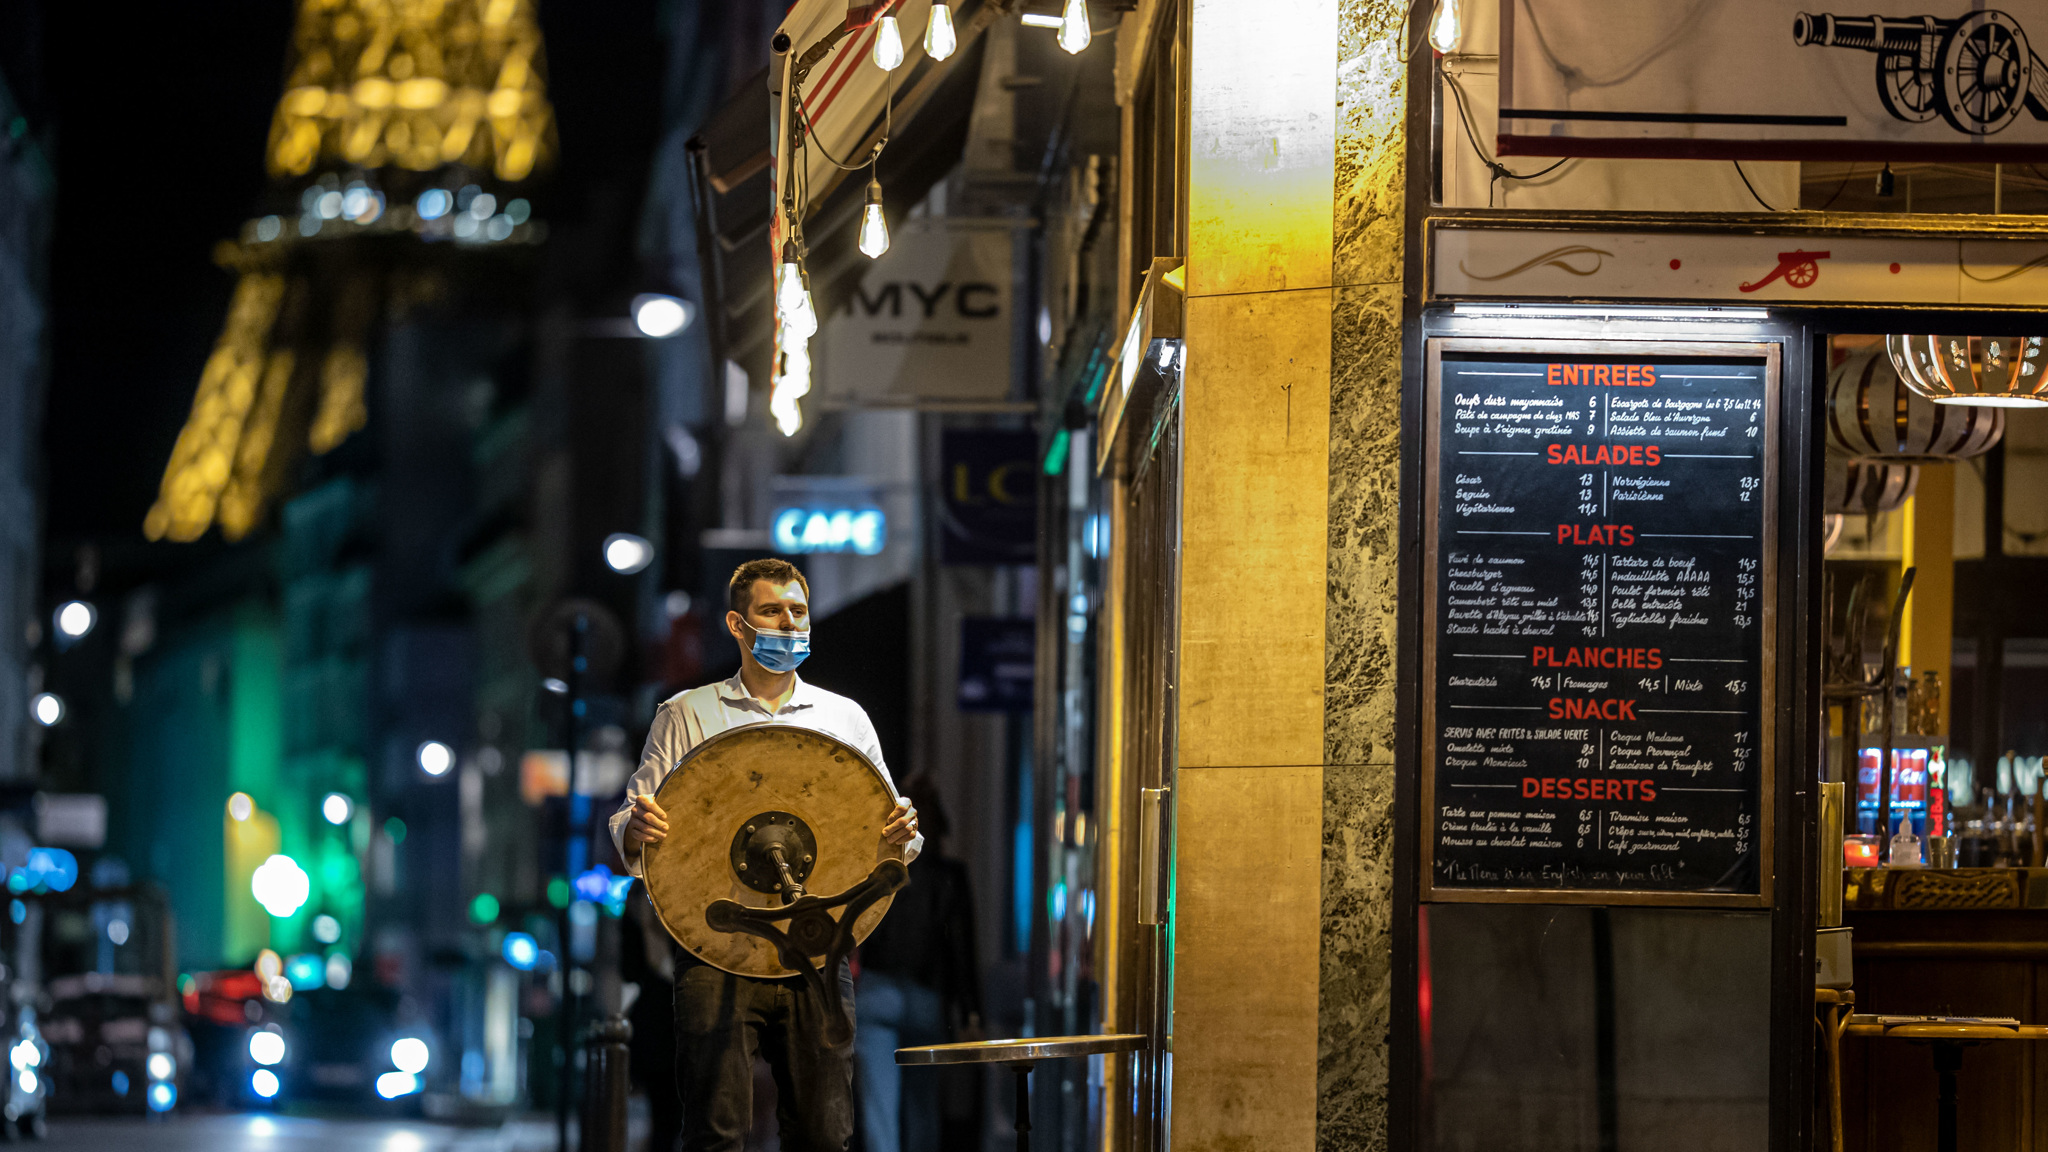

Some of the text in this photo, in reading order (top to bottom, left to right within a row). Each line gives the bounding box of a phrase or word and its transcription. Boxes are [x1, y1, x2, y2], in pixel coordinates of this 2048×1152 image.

[848, 282, 998, 318] MYC
[1547, 364, 1656, 387] ENTREES
[1455, 393, 1596, 411] Oeufs durs mayonnaise 6
[1611, 397, 1649, 411] Escargots
[1652, 399, 1662, 408] de
[1665, 399, 1702, 411] Bourgogne
[1715, 399, 1720, 408] 6
[1724, 399, 1734, 411] 7,5
[1752, 399, 1761, 409] 14
[1455, 409, 1596, 423] Pâté de campagne de chez MAS 7
[1610, 412, 1757, 425] Salade Bleu d'Auvergne 6
[1455, 423, 1595, 438] Soupe à l'oignon gratinée 9
[1610, 425, 1758, 440] Assiette de saumon fumé 10
[1547, 444, 1661, 466] SALADES
[1455, 474, 1593, 486] César 13
[1613, 476, 1760, 490] Norvégienne 13,5
[1455, 489, 1592, 501] Seguin 13
[1740, 492, 1750, 501] 12
[1456, 503, 1598, 516] Végétarienne 11,5
[1557, 524, 1635, 546] PLATS
[1448, 554, 1469, 564] Pavé
[1473, 554, 1484, 565] de
[1582, 555, 1599, 568] 14,5
[1611, 555, 1648, 567] Tartare
[1653, 557, 1664, 567] de
[1738, 558, 1757, 572] 14,5
[1581, 569, 1598, 582] 14,5
[1611, 571, 1754, 585] Andouillette AAAAA 15,5
[1449, 581, 1598, 596] Rouelle d'agneau 14,9
[1611, 585, 1643, 595] Poulet
[1644, 587, 1686, 600] fermier
[1737, 588, 1754, 599] 14,5
[1448, 596, 1497, 606] Camembert
[1537, 598, 1558, 606] miel
[1580, 598, 1598, 609] 13,5
[1611, 599, 1747, 611] Belle entrecôte 21
[1448, 609, 1483, 619] Bavette
[1587, 610, 1599, 623] 14,5
[1611, 612, 1666, 628] Tagliatelles
[1733, 615, 1752, 629] 13,5
[1446, 624, 1597, 637] Steack haché à cheval 14,5
[1532, 646, 1663, 669] PLANCHES
[1449, 676, 1551, 689] Charcuterie 14,5
[1563, 677, 1660, 693] Fromages 14,5
[1675, 680, 1747, 695] Mixte 15,5
[1549, 697, 1636, 721] SNACK
[1444, 727, 1473, 739] SERVIS
[1476, 728, 1496, 739] AVEC
[1498, 728, 1525, 740] FRITES
[1534, 729, 1562, 740] SALADE
[1564, 729, 1588, 740] VERTE
[1611, 731, 1748, 745] Croque Madame 11
[1447, 743, 1485, 752] Omelette
[1490, 744, 1514, 753] mixte
[1610, 745, 1751, 760] Croque Provençal 12,5
[1446, 757, 1589, 769] Croque Monsieur 10
[1609, 760, 1654, 770] Saucisses
[1657, 761, 1668, 770] de
[1733, 761, 1745, 771] 10
[1522, 777, 1656, 801] DESSERTS
[1442, 806, 1466, 817] Tarte
[1488, 810, 1521, 824] pommes
[1525, 809, 1556, 819] maison
[1579, 810, 1593, 821] 6,5
[1609, 811, 1751, 825] Tiramisu maison 6,5
[1441, 821, 1467, 831] Crème
[1500, 824, 1506, 832] à
[1509, 823, 1519, 832] la
[1522, 823, 1552, 833] vanille
[1578, 824, 1591, 836] 6,5
[1609, 826, 1749, 840] Crêpe 5,5
[1441, 837, 1473, 845] Mousse
[1491, 837, 1526, 847] chocolat
[1529, 837, 1563, 848] maison
[1577, 838, 1583, 848] 6
[1608, 840, 1748, 856] Café gourmand 9,5
